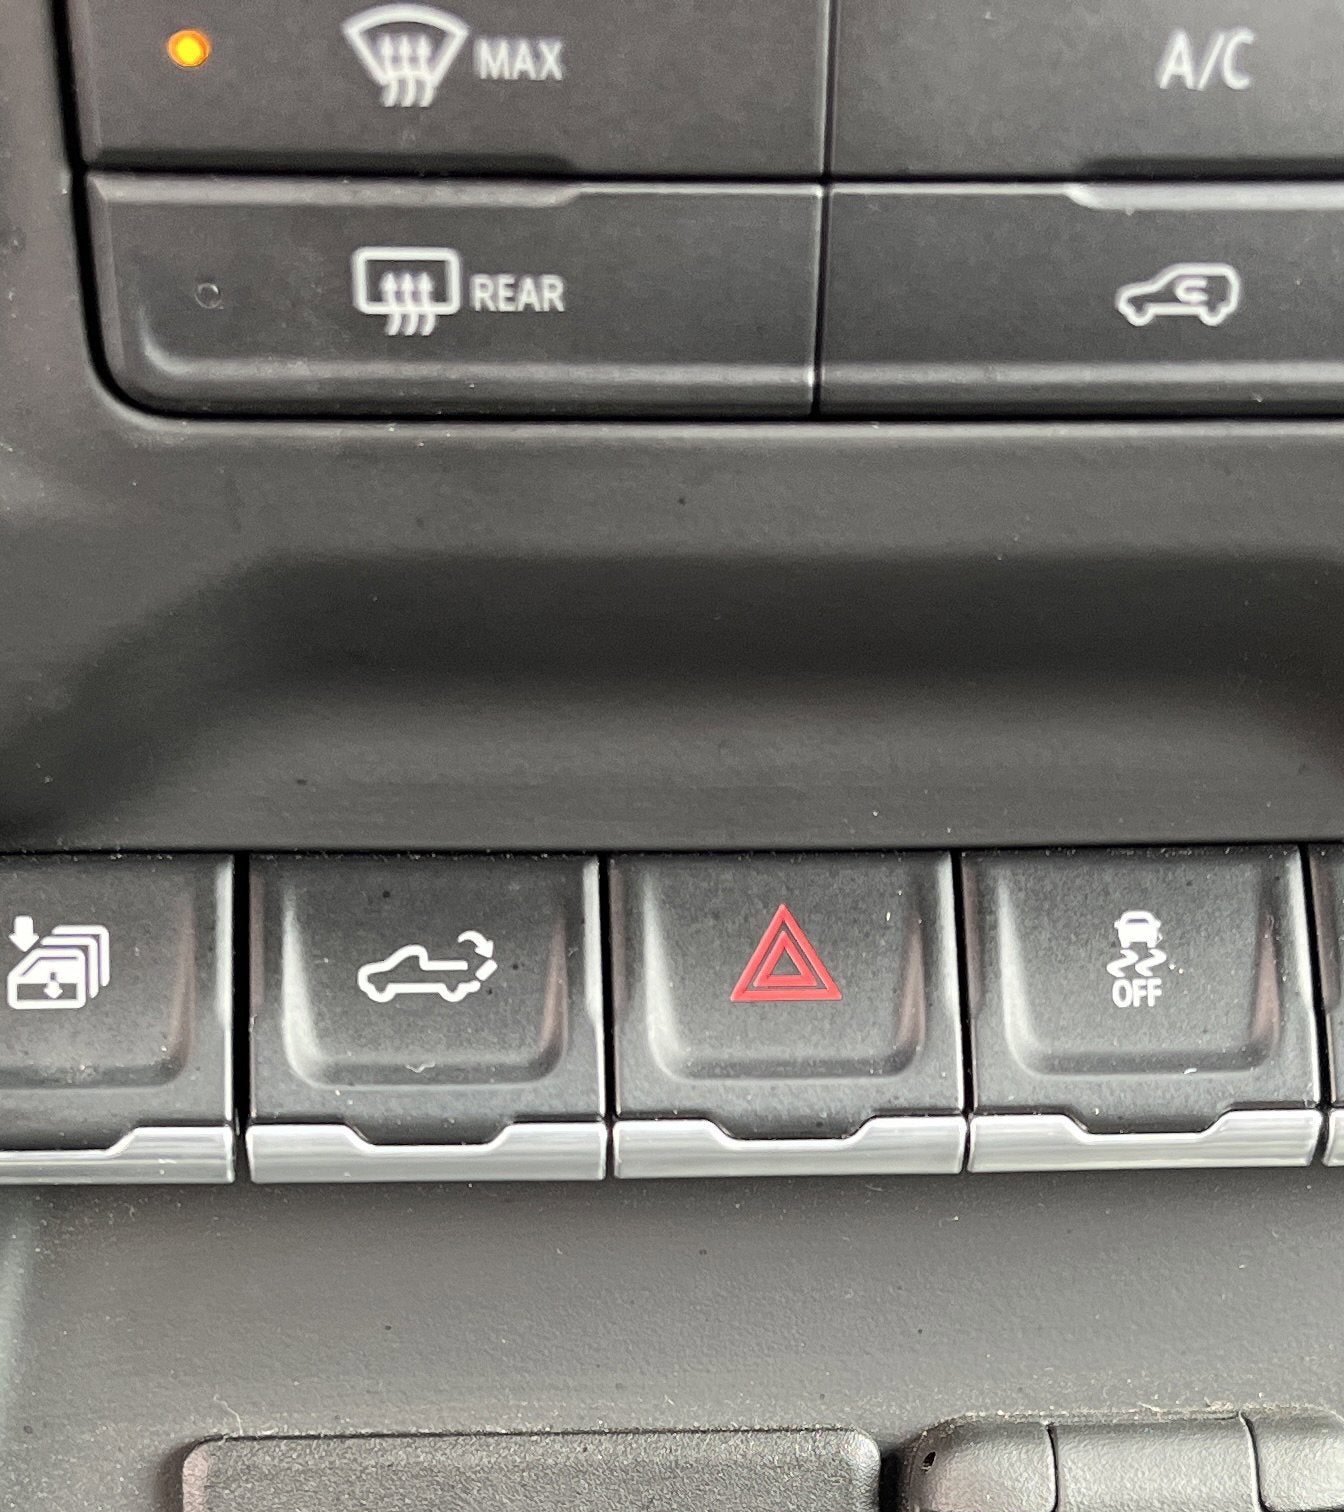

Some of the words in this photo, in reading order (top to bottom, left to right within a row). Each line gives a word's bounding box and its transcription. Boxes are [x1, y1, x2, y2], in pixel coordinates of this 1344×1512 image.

[474, 37, 564, 81] MAX
[1158, 27, 1254, 91] A/C
[470, 273, 565, 312] REAR
[1112, 977, 1163, 1008] OFF
